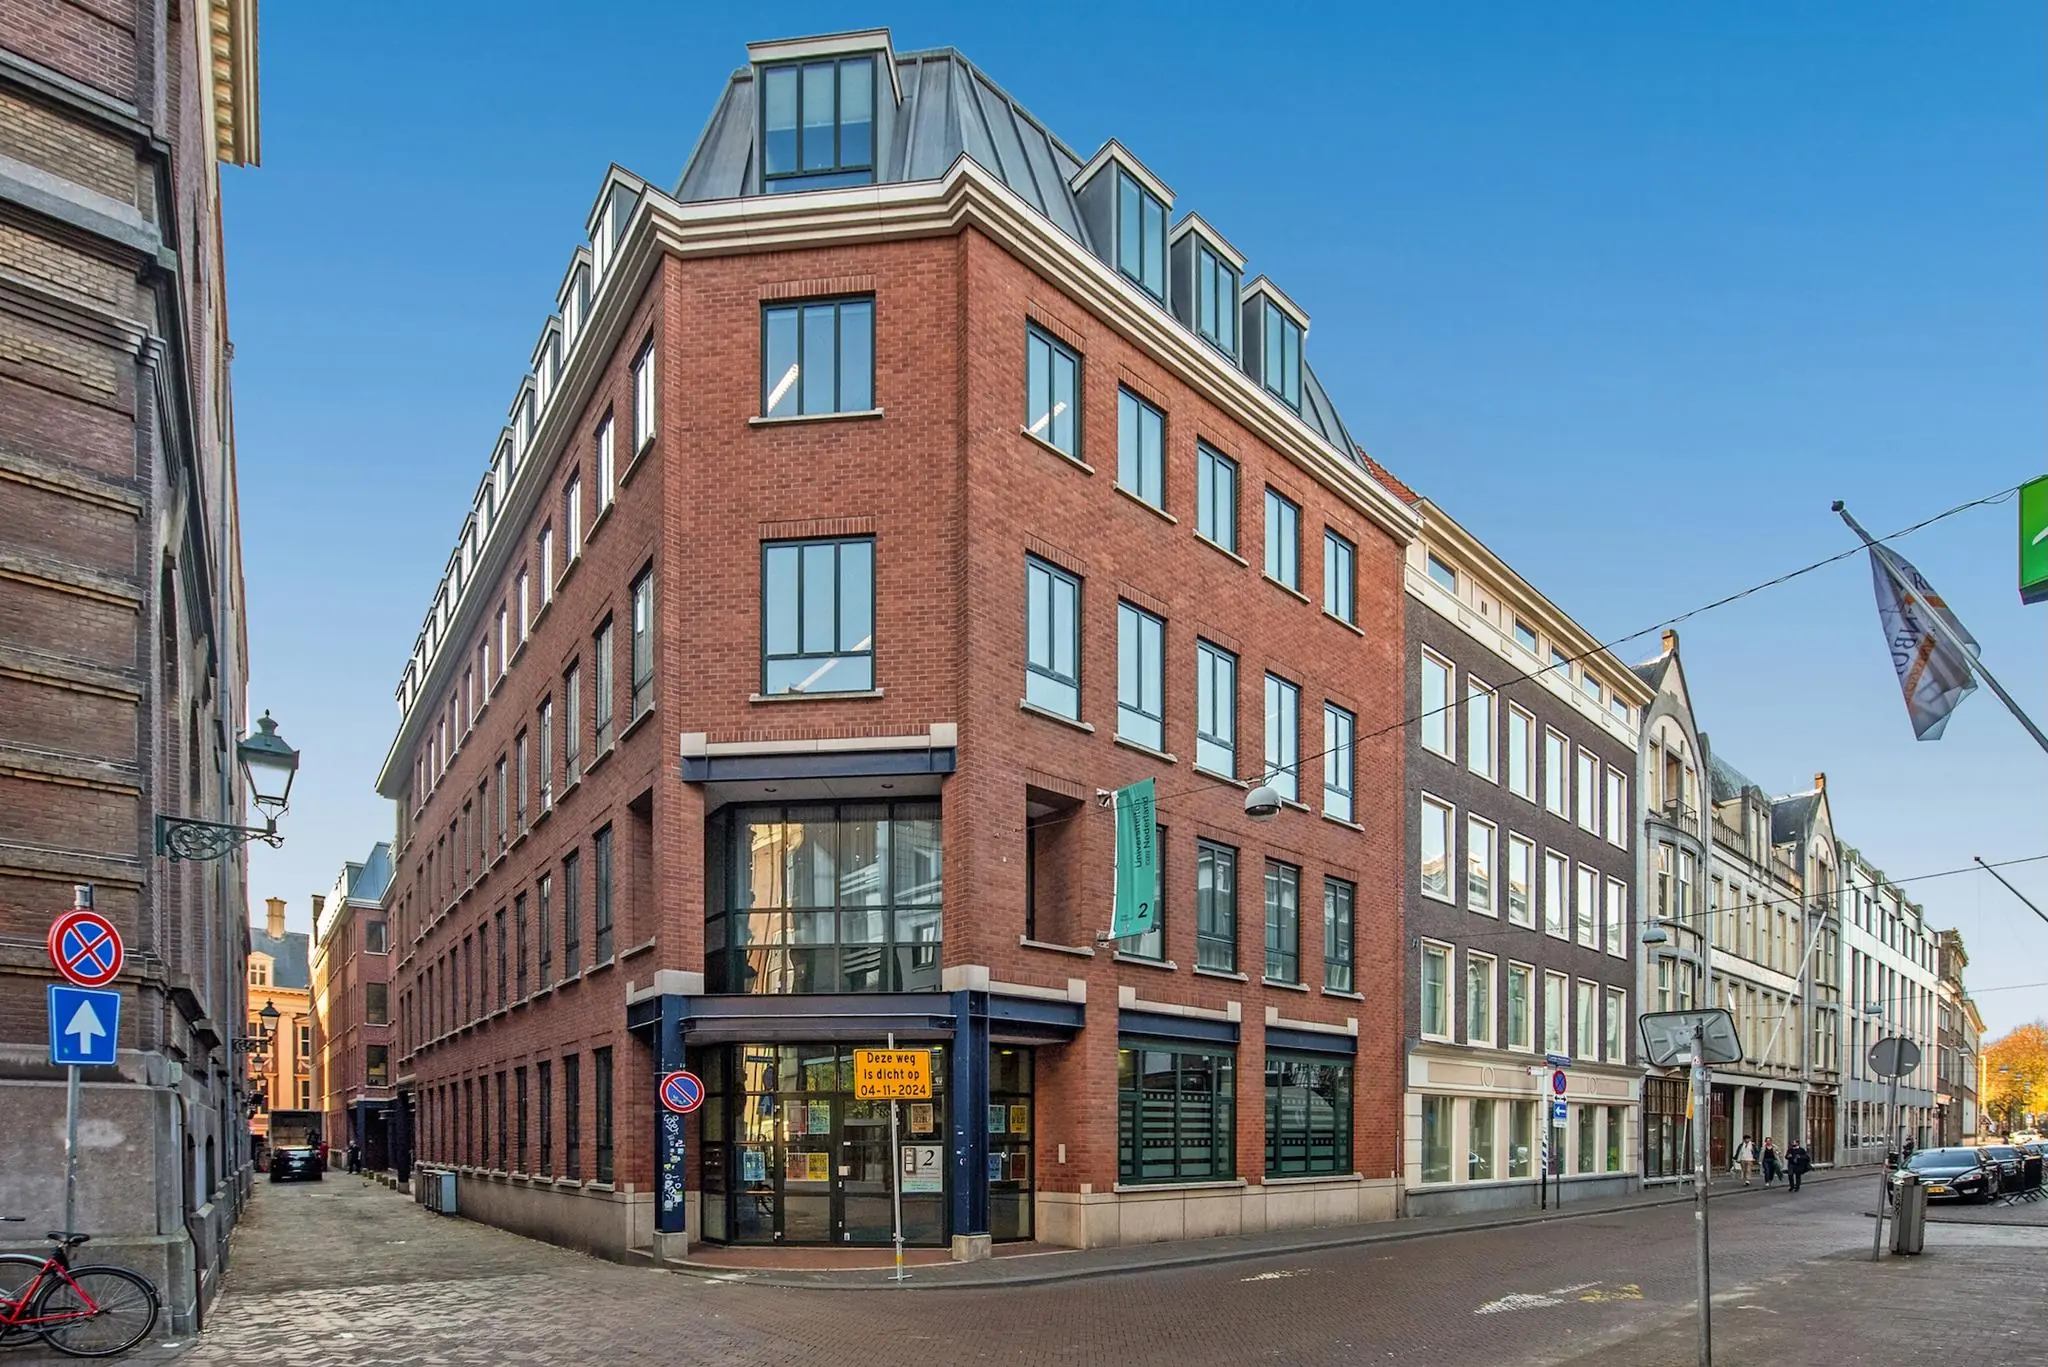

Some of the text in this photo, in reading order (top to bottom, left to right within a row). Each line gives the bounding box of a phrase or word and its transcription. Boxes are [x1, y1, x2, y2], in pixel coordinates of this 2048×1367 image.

[1142, 796, 1151, 849] Nederland
[1134, 798, 1142, 868] Universiteiten
[1138, 902, 1148, 919] 2
[867, 1052, 916, 1066] Deze weg
[864, 1068, 920, 1081] is dicht op
[860, 1084, 926, 1096] 04-11-2024
[922, 1149, 935, 1167] 2
